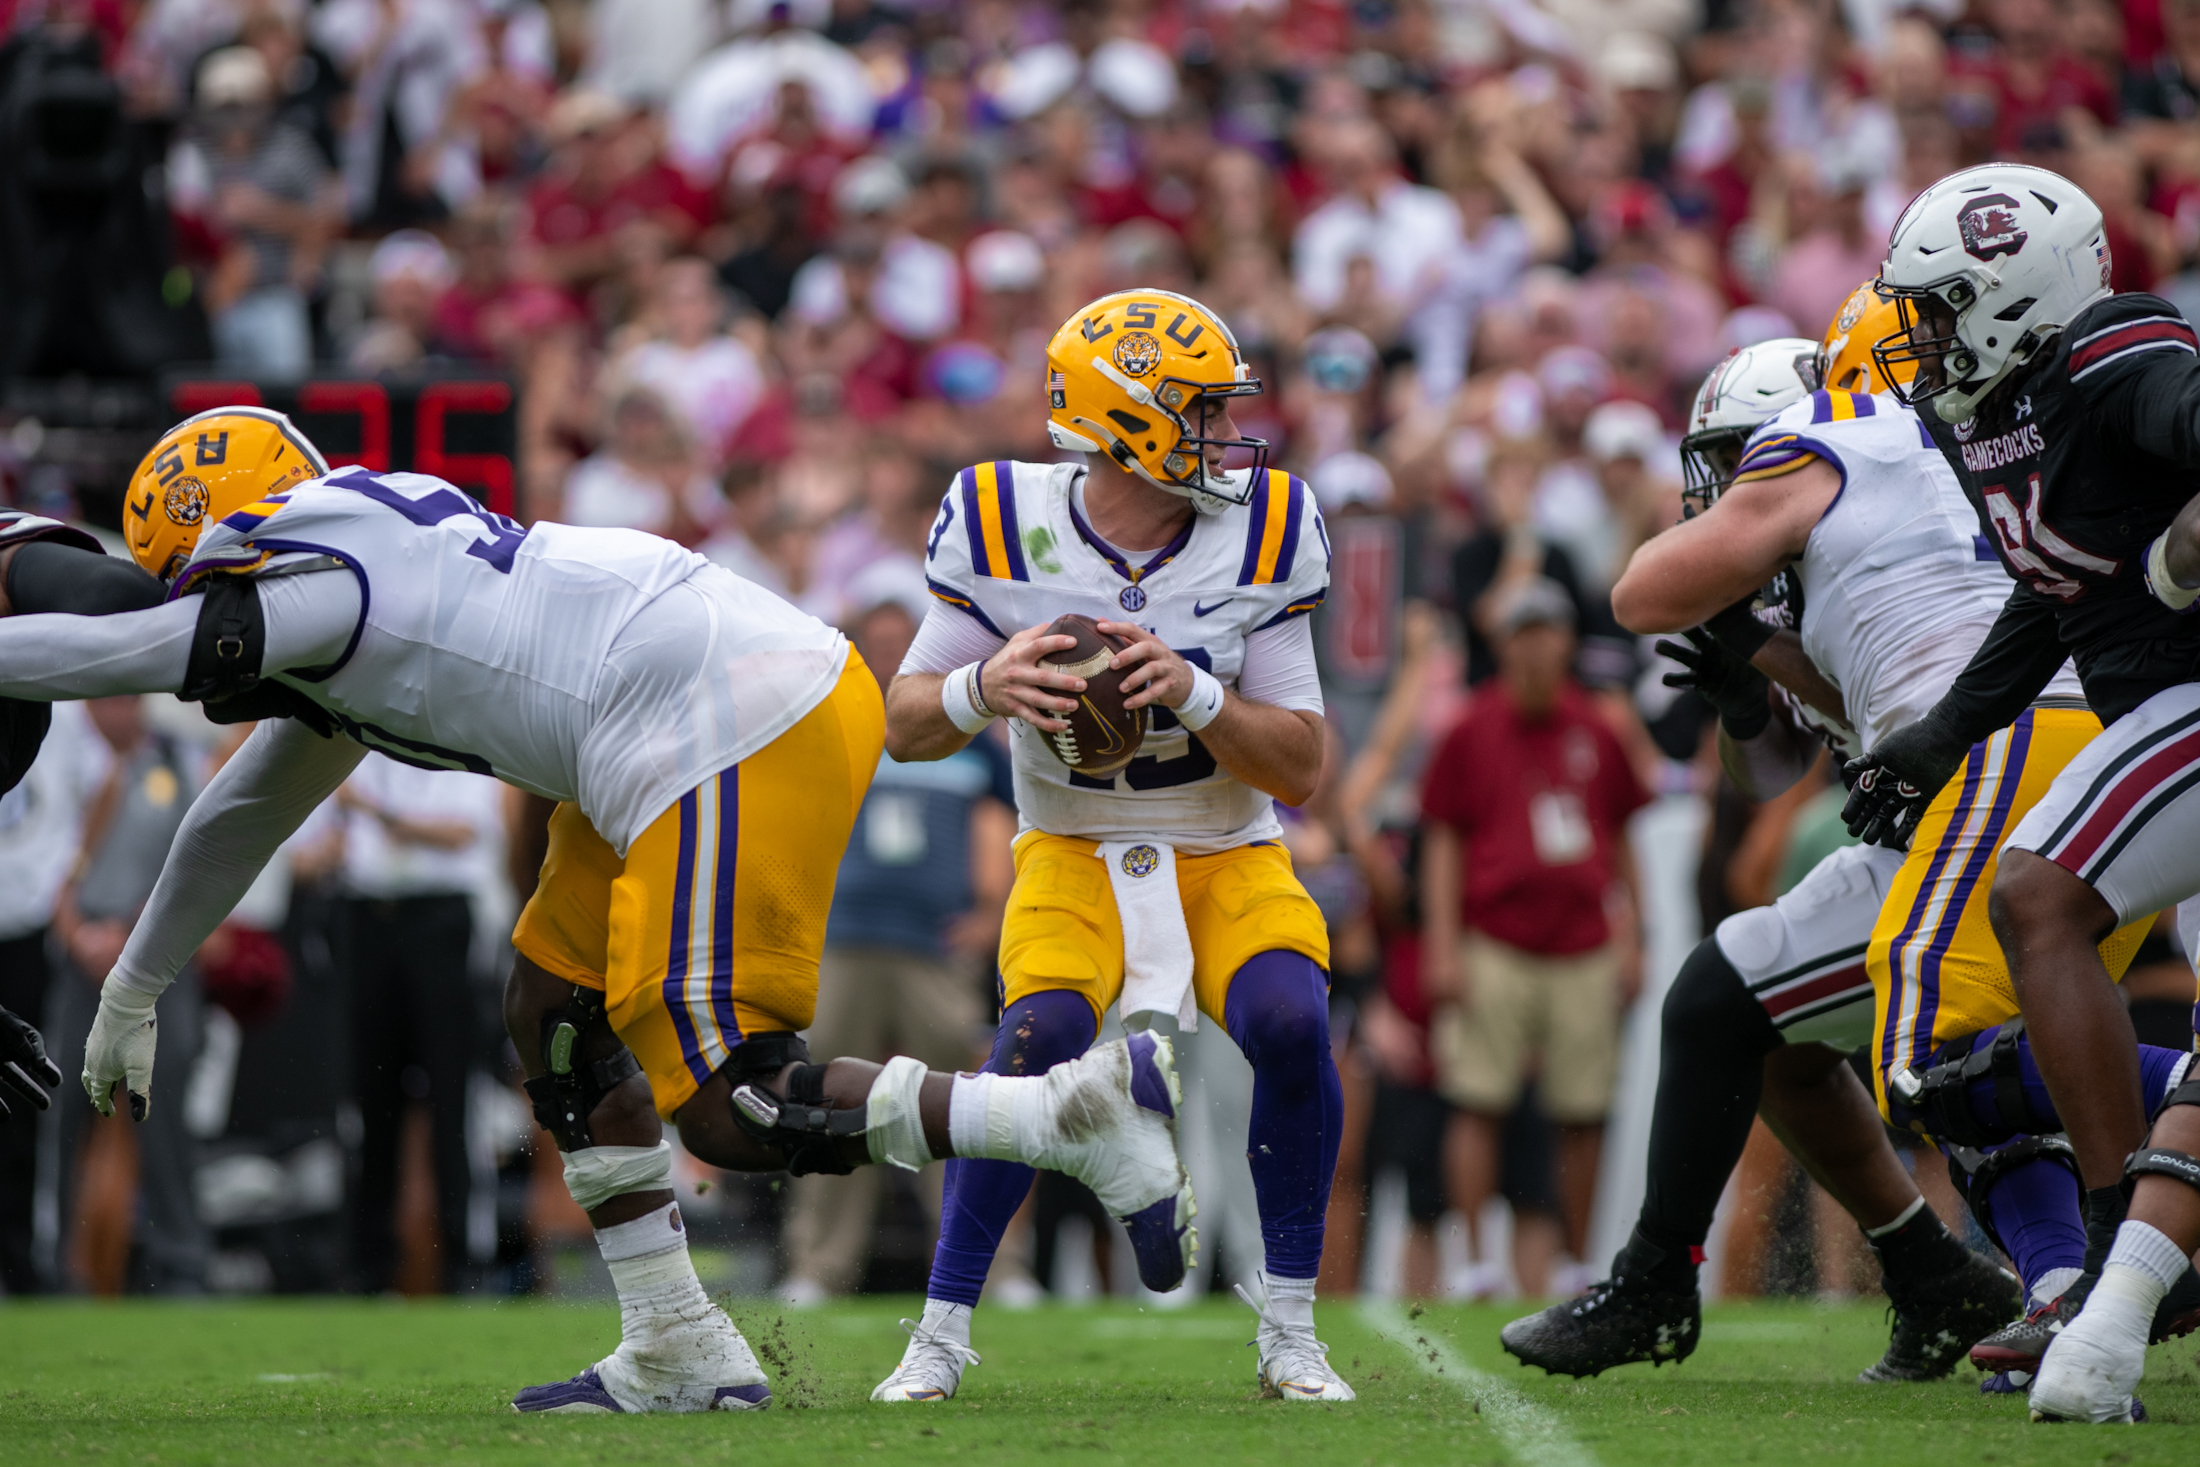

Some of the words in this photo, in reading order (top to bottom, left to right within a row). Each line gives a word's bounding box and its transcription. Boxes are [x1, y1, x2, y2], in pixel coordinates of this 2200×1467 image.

[1081, 302, 1205, 349] LSU
[1961, 422, 2046, 473] GAMECOCKS
[130, 431, 229, 522] LSU
[1120, 587, 1146, 611] SEC
[2149, 1153, 2200, 1172] DONJO
